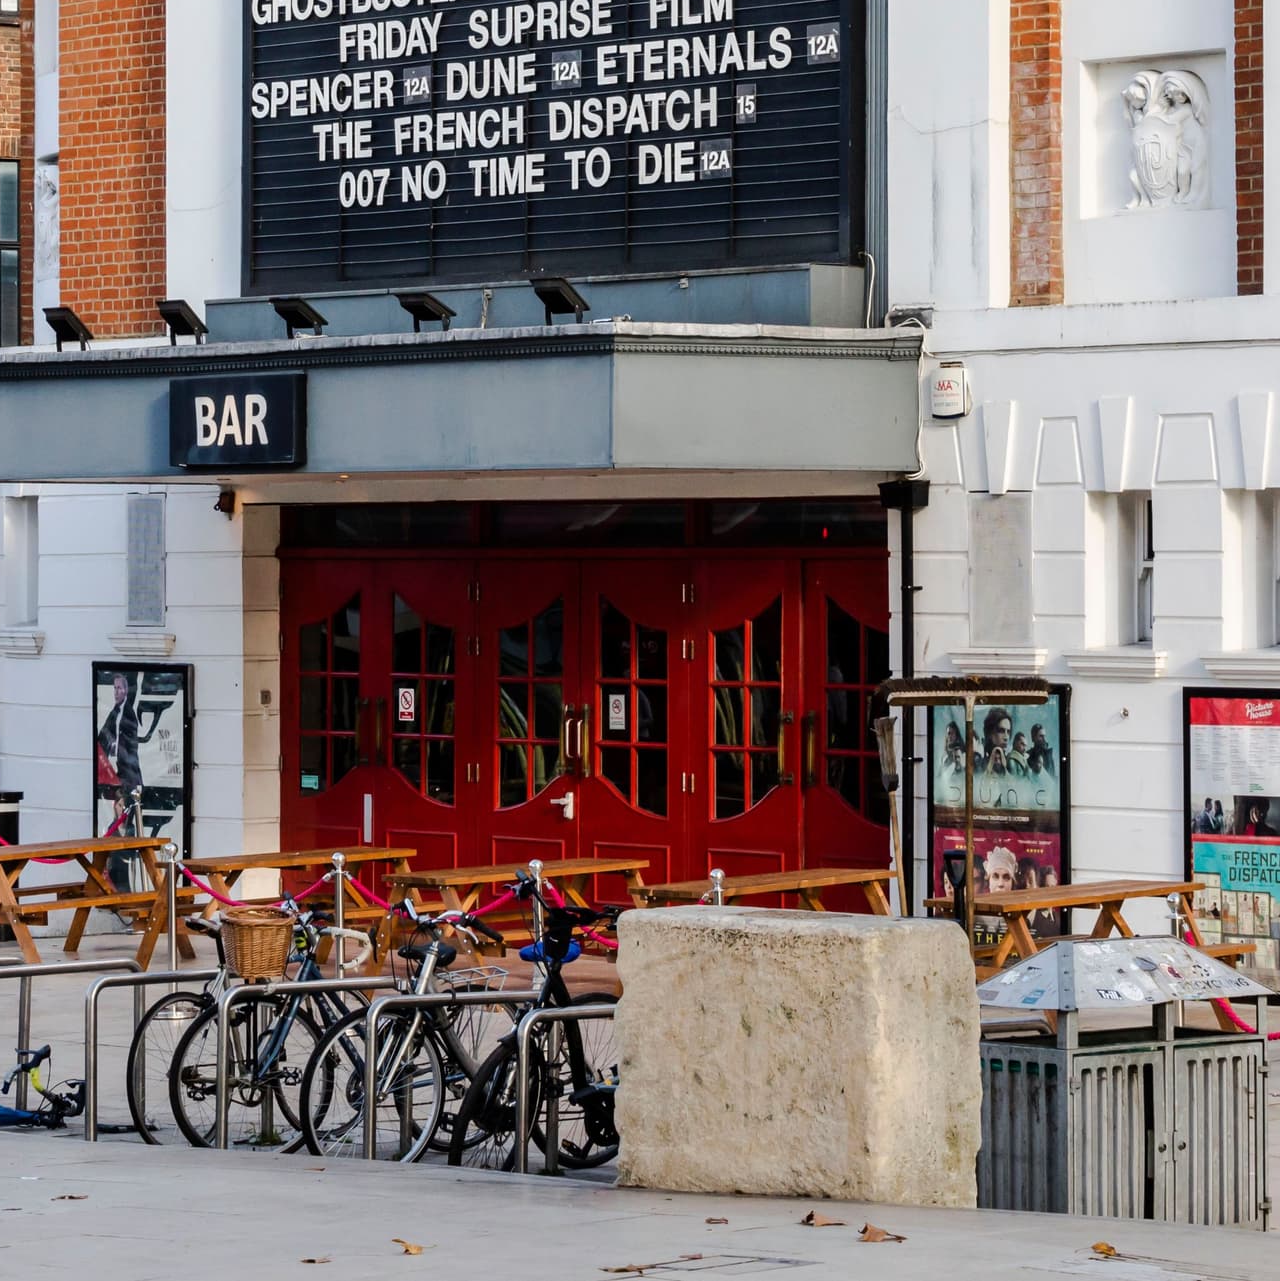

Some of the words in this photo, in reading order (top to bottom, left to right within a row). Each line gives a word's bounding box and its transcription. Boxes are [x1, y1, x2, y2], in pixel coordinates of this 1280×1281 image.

[339, 12, 442, 64] FRIDAY
[251, 70, 394, 120] SPENCER
[404, 76, 429, 97] 12A
[446, 54, 536, 102] DUNE
[552, 60, 579, 82] 12A
[597, 26, 792, 86] ETERNALS
[808, 34, 838, 55] 12A
[313, 121, 372, 161] THE
[394, 103, 524, 156] FRENCH
[549, 88, 718, 141] DISPATCH
[737, 95, 755, 115] 15
[339, 168, 389, 209] 007
[401, 161, 445, 204] NO
[469, 152, 545, 198] TIME
[565, 148, 611, 190] TO
[638, 141, 695, 185] DIE
[700, 150, 730, 171] 12A
[195, 393, 269, 448] BAR
[1245, 701, 1274, 716] Picture
